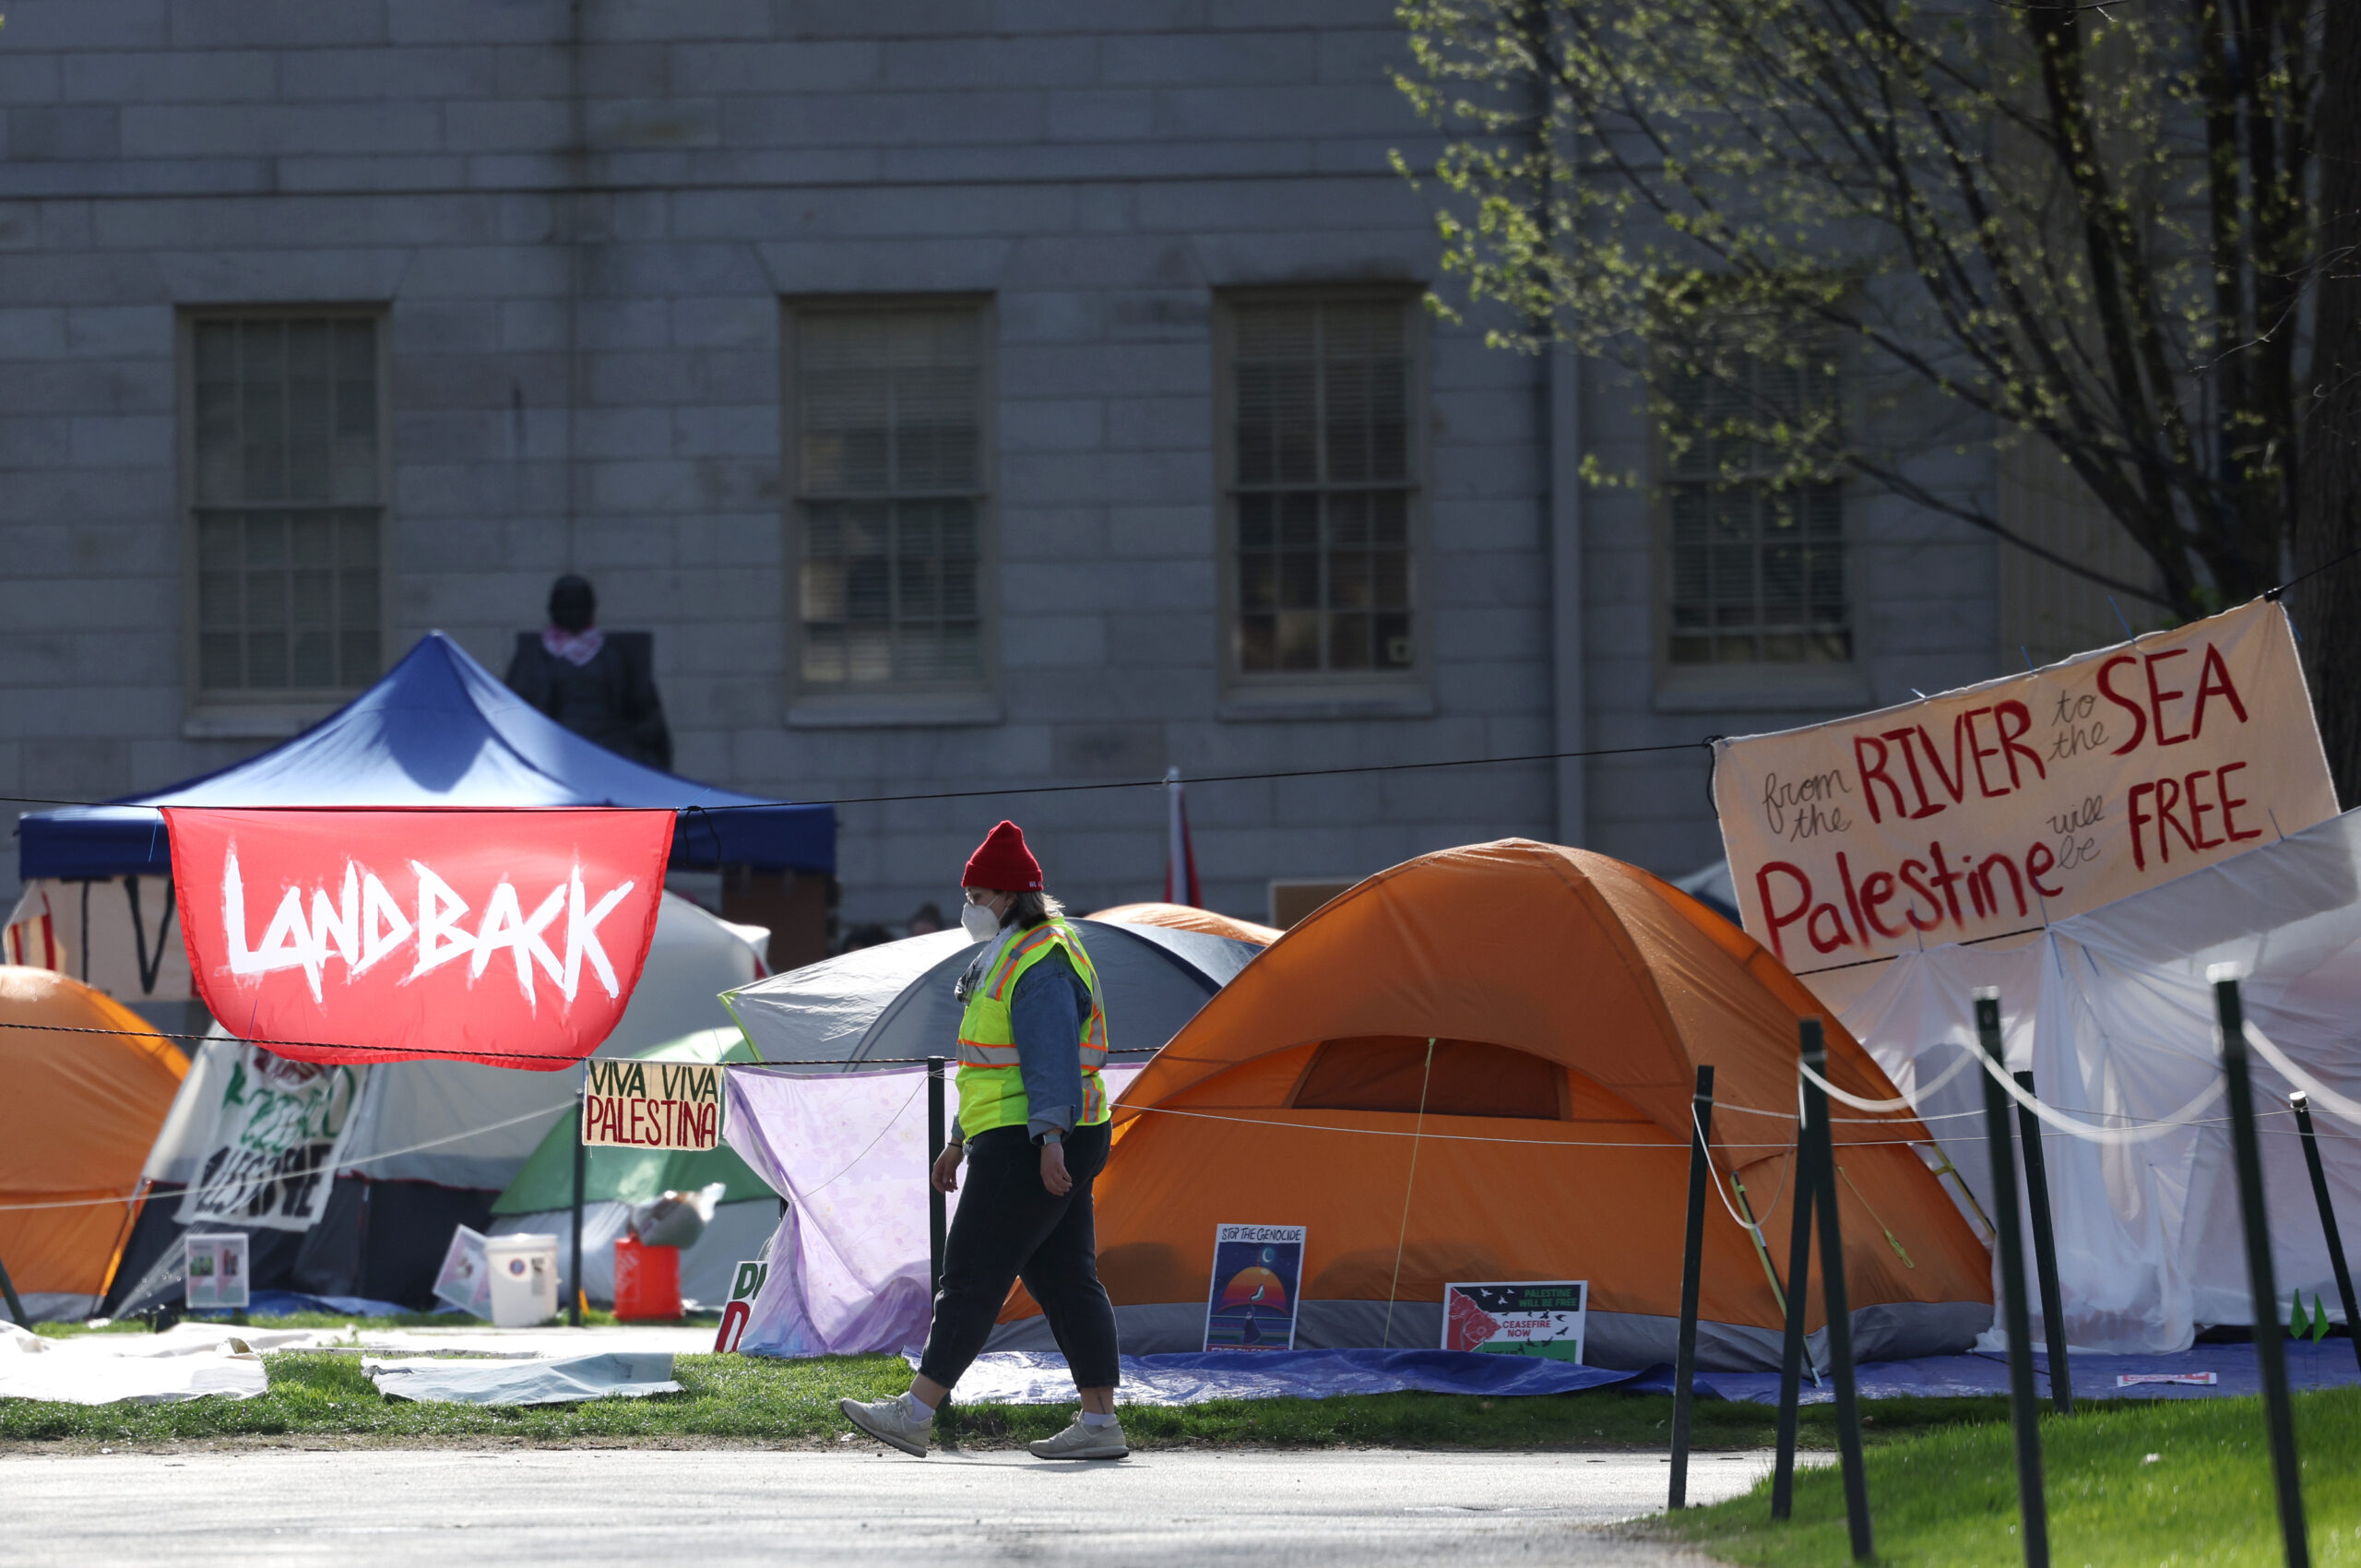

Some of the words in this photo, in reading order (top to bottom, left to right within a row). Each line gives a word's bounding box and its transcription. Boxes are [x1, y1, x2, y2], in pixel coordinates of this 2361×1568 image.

[2051, 690, 2095, 727] to
[2096, 643, 2248, 755] SEA
[1854, 698, 2047, 825] RIVER
[2047, 719, 2109, 763] the
[1762, 768, 1852, 834] from
[1790, 801, 1853, 843] the
[2046, 795, 2106, 836] will
[2128, 761, 2263, 873] FREE
[2056, 832, 2102, 872] be
[1756, 840, 2064, 964] Palestine
[588, 1061, 647, 1099] VIVA
[661, 1063, 718, 1103] VIVA
[587, 1095, 717, 1147] PALESTINA
[1221, 1227, 1240, 1241] STOP
[1240, 1227, 1255, 1241] THE
[1256, 1228, 1302, 1241] GENOCIDE
[1518, 1298, 1540, 1307] WILL
[1541, 1298, 1553, 1307] BE
[1555, 1297, 1578, 1307] FREE
[1524, 1289, 1572, 1298] PALESTINE
[1502, 1320, 1551, 1329] CEASEFIRE
[1507, 1329, 1532, 1337] NOW
